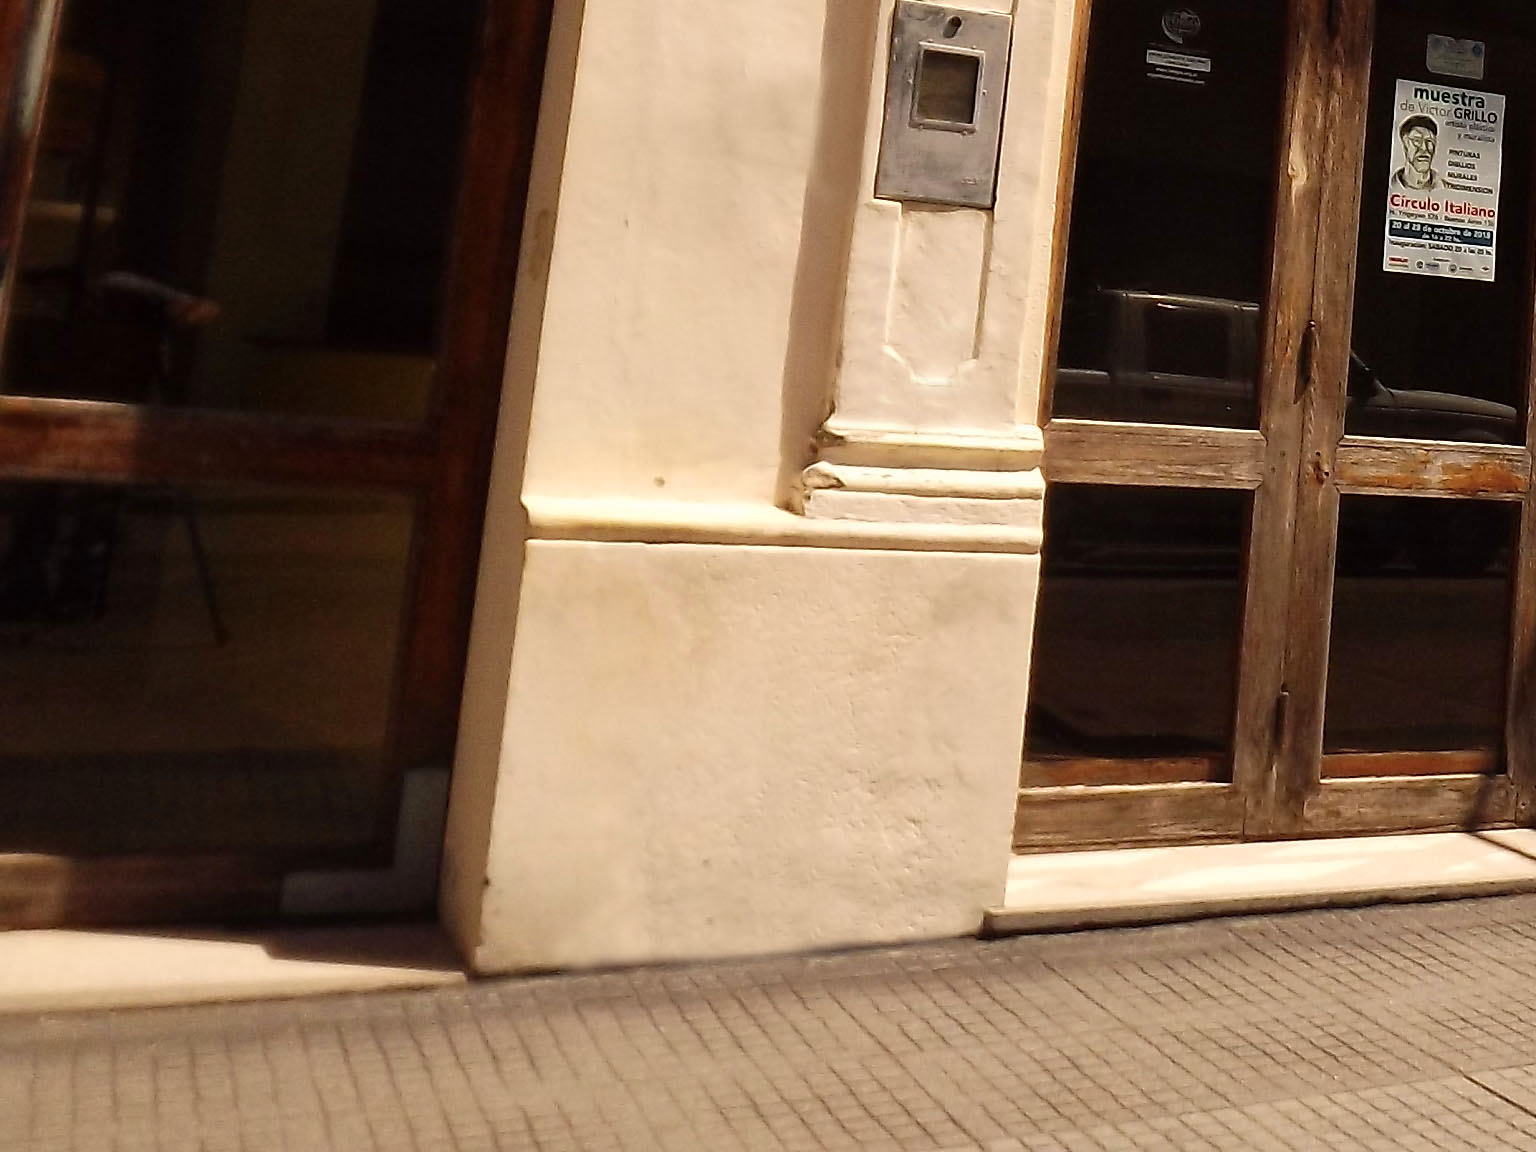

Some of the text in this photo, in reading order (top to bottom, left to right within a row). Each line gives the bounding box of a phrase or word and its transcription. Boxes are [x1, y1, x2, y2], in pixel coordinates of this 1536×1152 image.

[1413, 87, 1485, 108] muestra
[1400, 100, 1415, 112] de
[1454, 108, 1498, 124] GRILLO
[1445, 200, 1496, 218] Italiano
